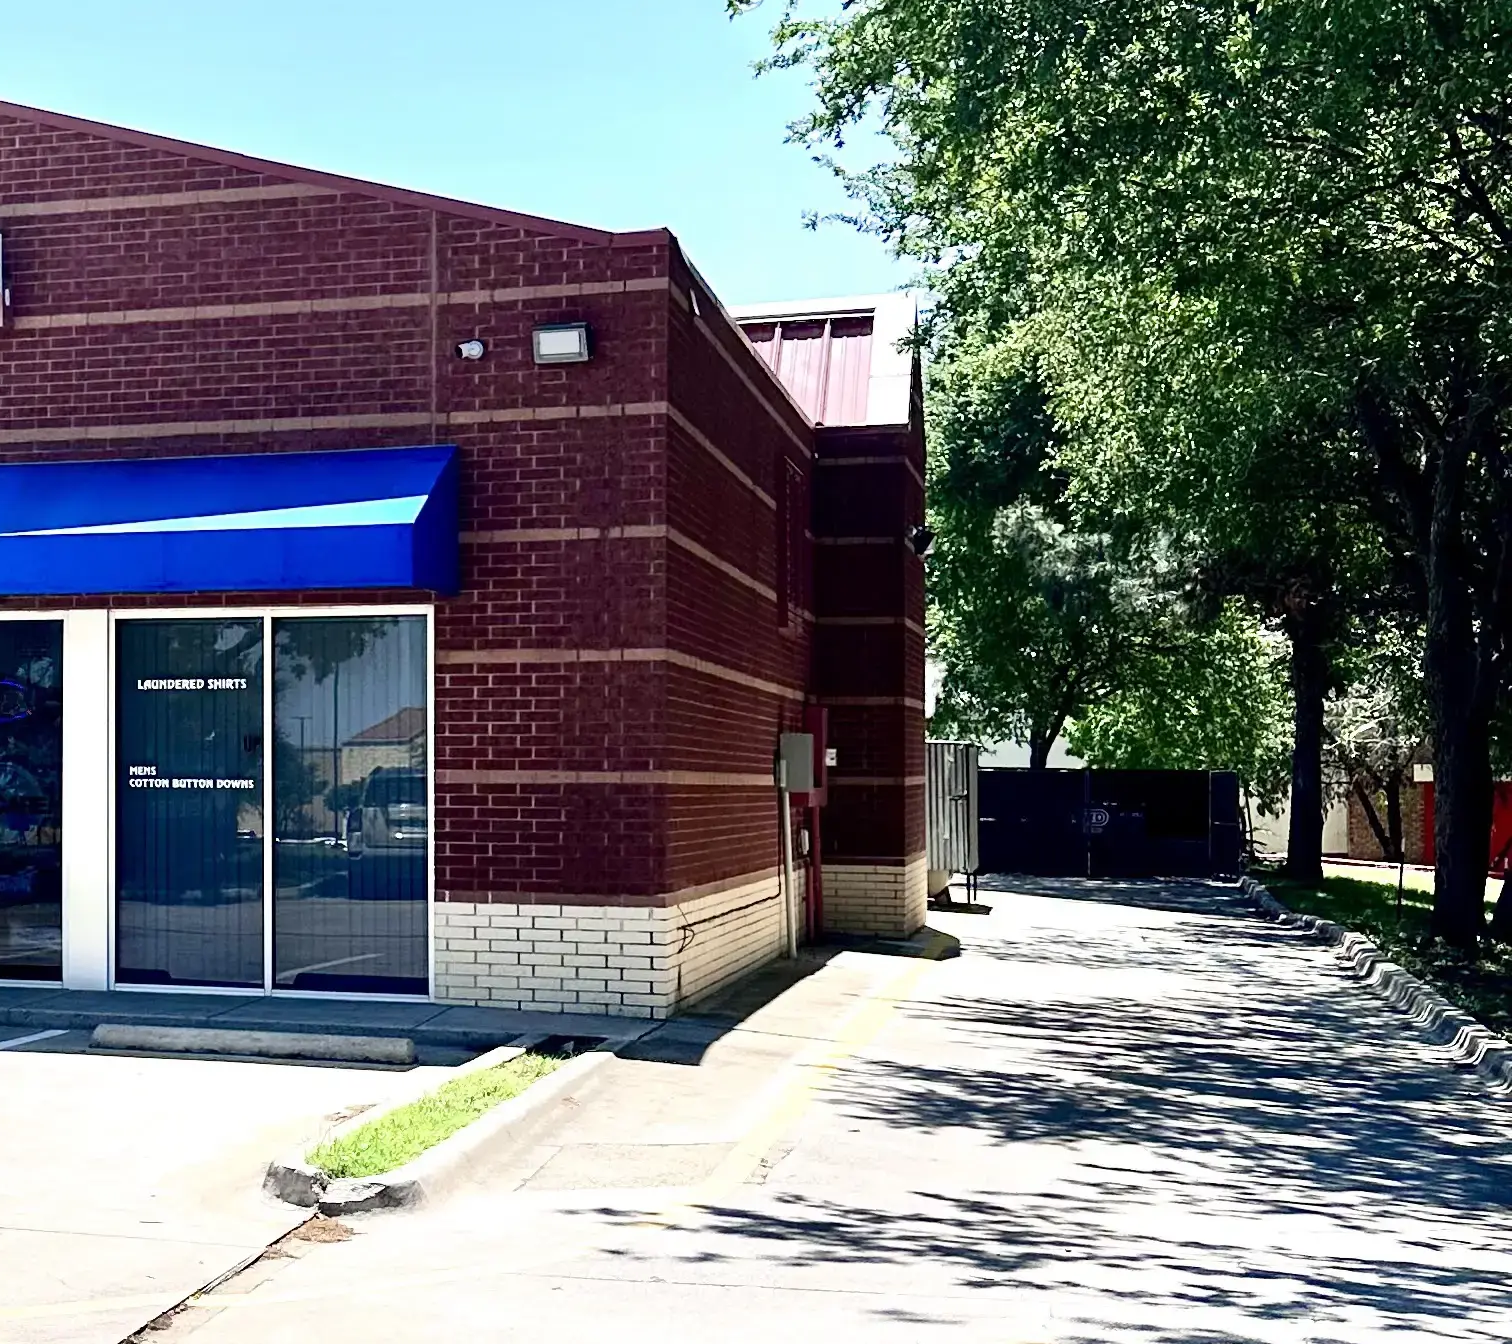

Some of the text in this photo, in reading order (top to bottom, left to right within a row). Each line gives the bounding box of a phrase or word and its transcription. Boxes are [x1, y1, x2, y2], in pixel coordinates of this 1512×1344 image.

[138, 679, 247, 690] LAUNDERED SHIRTS
[129, 766, 157, 776] MENS
[129, 779, 255, 789] COTTON BUTTON DOWNS
